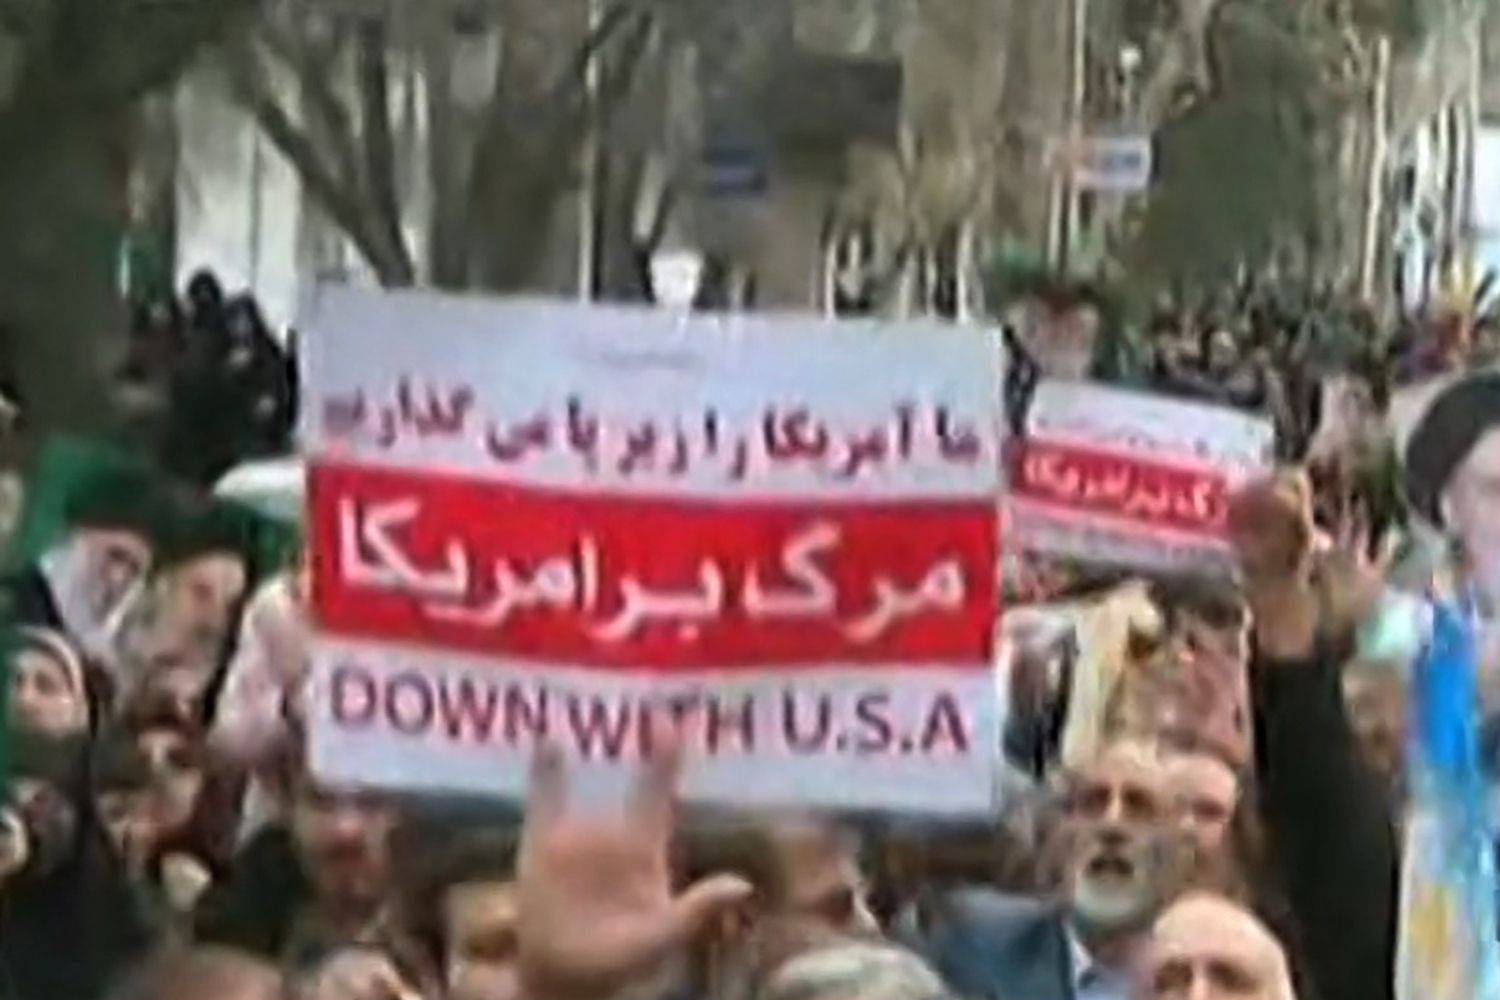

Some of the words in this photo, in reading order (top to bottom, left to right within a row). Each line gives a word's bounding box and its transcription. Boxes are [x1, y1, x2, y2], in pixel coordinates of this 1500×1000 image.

[588, 555, 724, 642] بر
[330, 665, 549, 747] DOWN
[565, 690, 756, 763] WITH
[782, 690, 968, 757] U.S.A
